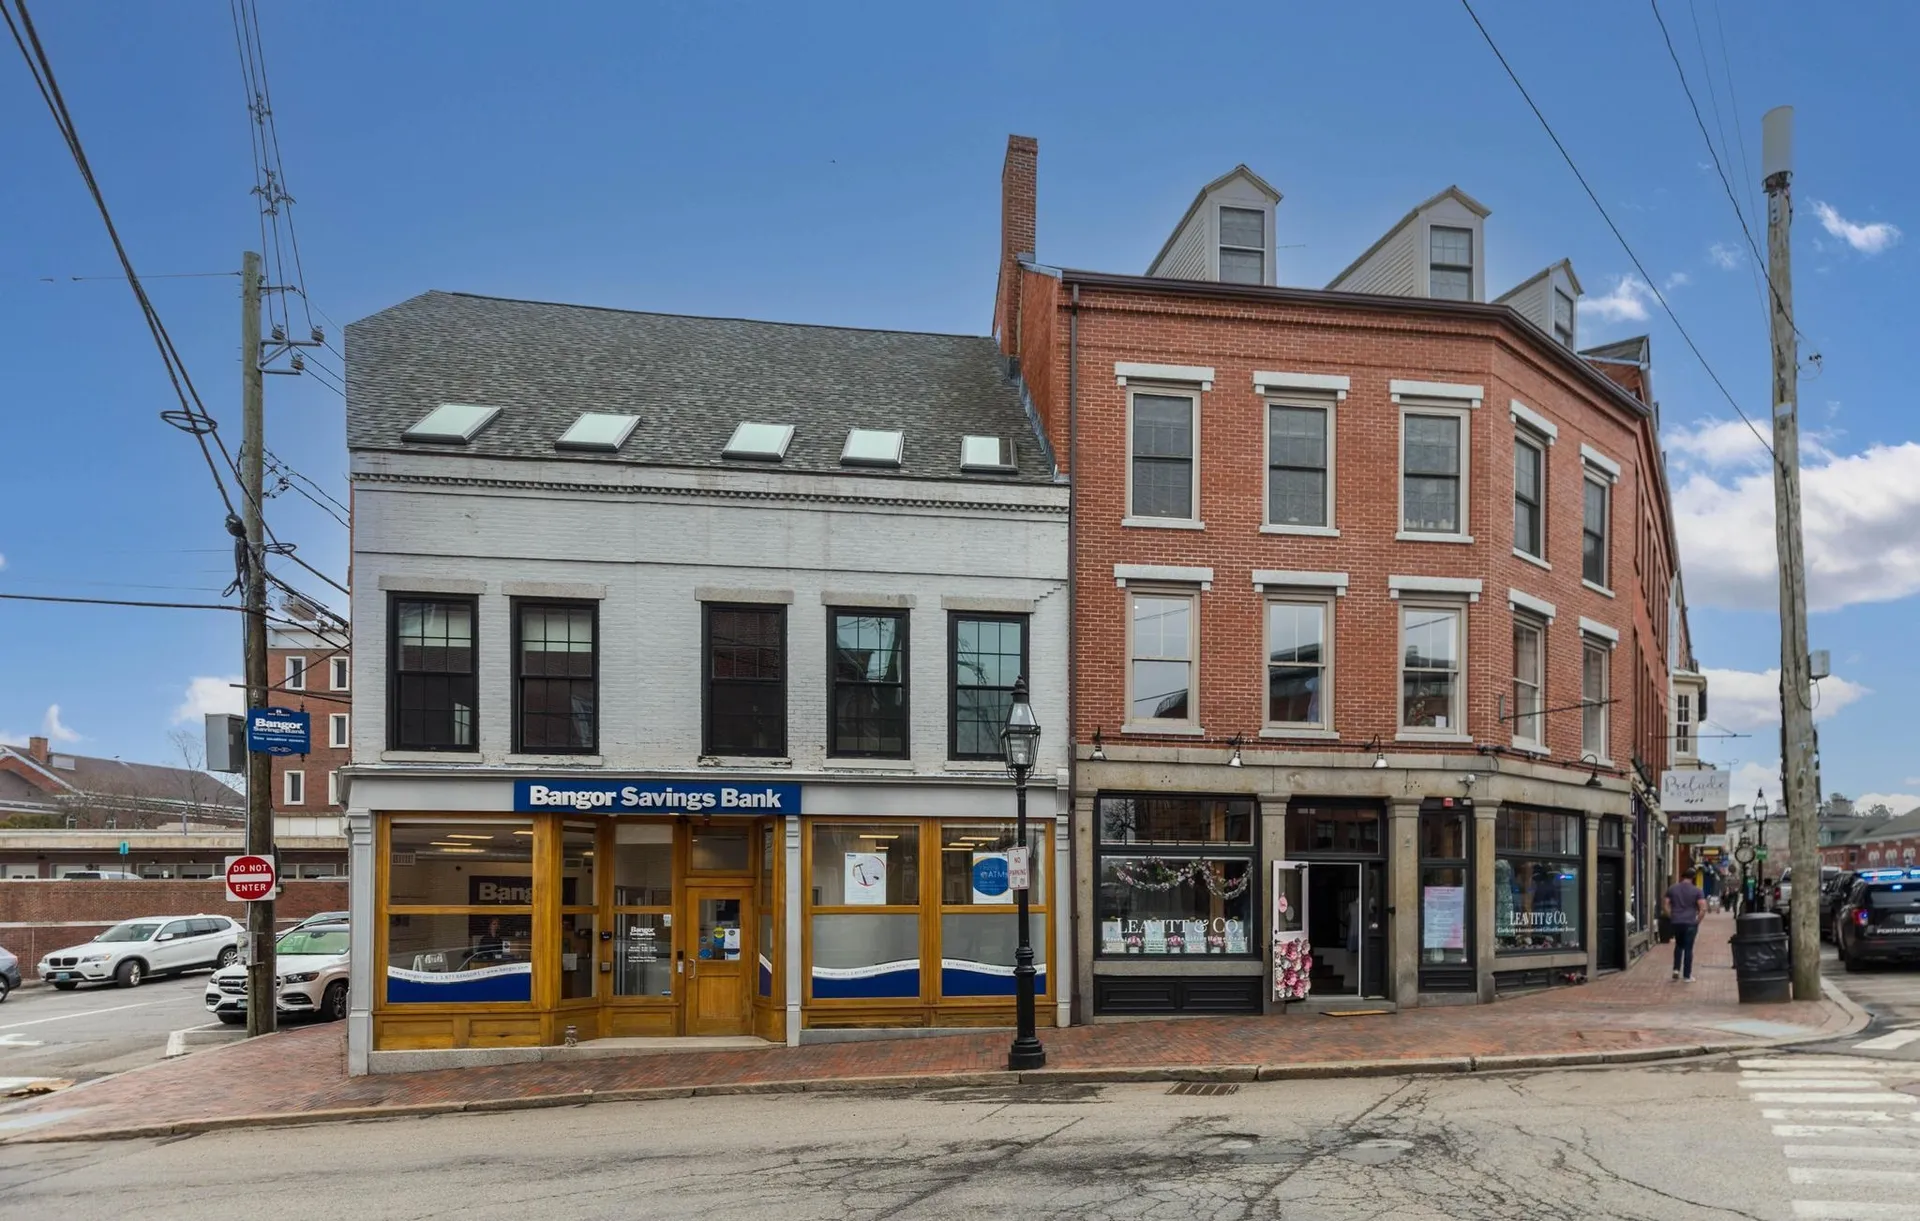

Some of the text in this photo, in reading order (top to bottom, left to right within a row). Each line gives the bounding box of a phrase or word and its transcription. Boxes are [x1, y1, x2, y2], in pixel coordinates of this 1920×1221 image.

[253, 726, 284, 734] Savings
[255, 718, 303, 730] Bangor
[1664, 775, 1724, 792] Prelude
[529, 785, 782, 812] Bangor Savings Bank
[1013, 856, 1022, 865] NO
[233, 864, 268, 873] DO NOT
[235, 883, 267, 892] ENTER
[1510, 910, 1545, 926] LEAVITT
[1545, 912, 1553, 925] &
[1115, 917, 1190, 933] LEAVITT
[1194, 919, 1209, 933] &
